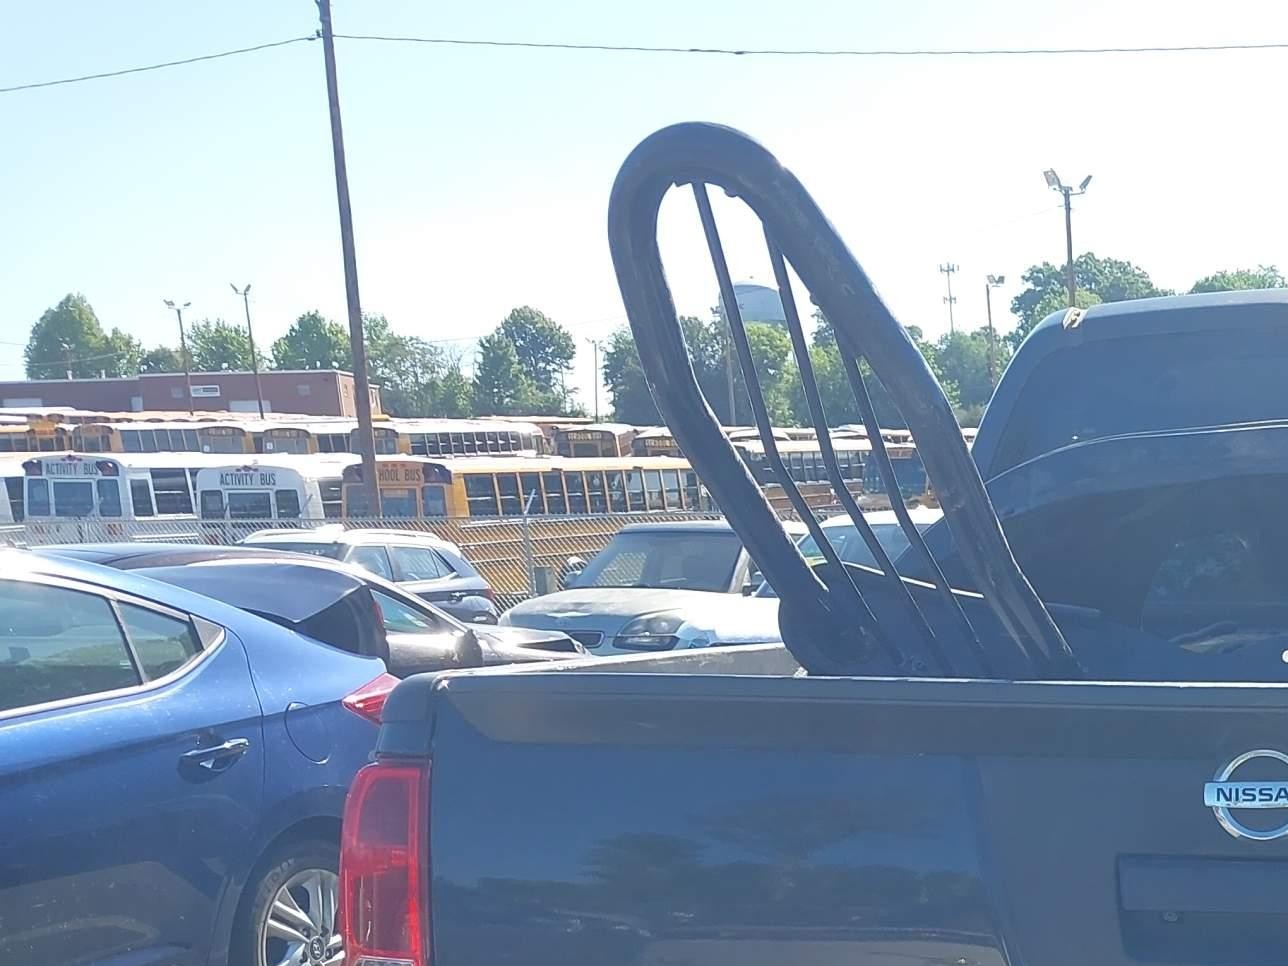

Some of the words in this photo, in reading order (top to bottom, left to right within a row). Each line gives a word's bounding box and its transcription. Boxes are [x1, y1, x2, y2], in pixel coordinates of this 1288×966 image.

[45, 462, 78, 476] ACTIVITY
[83, 462, 99, 476] BUS
[404, 468, 421, 481] BUS
[220, 473, 254, 486] ACTIVITY
[260, 473, 276, 486] BUS
